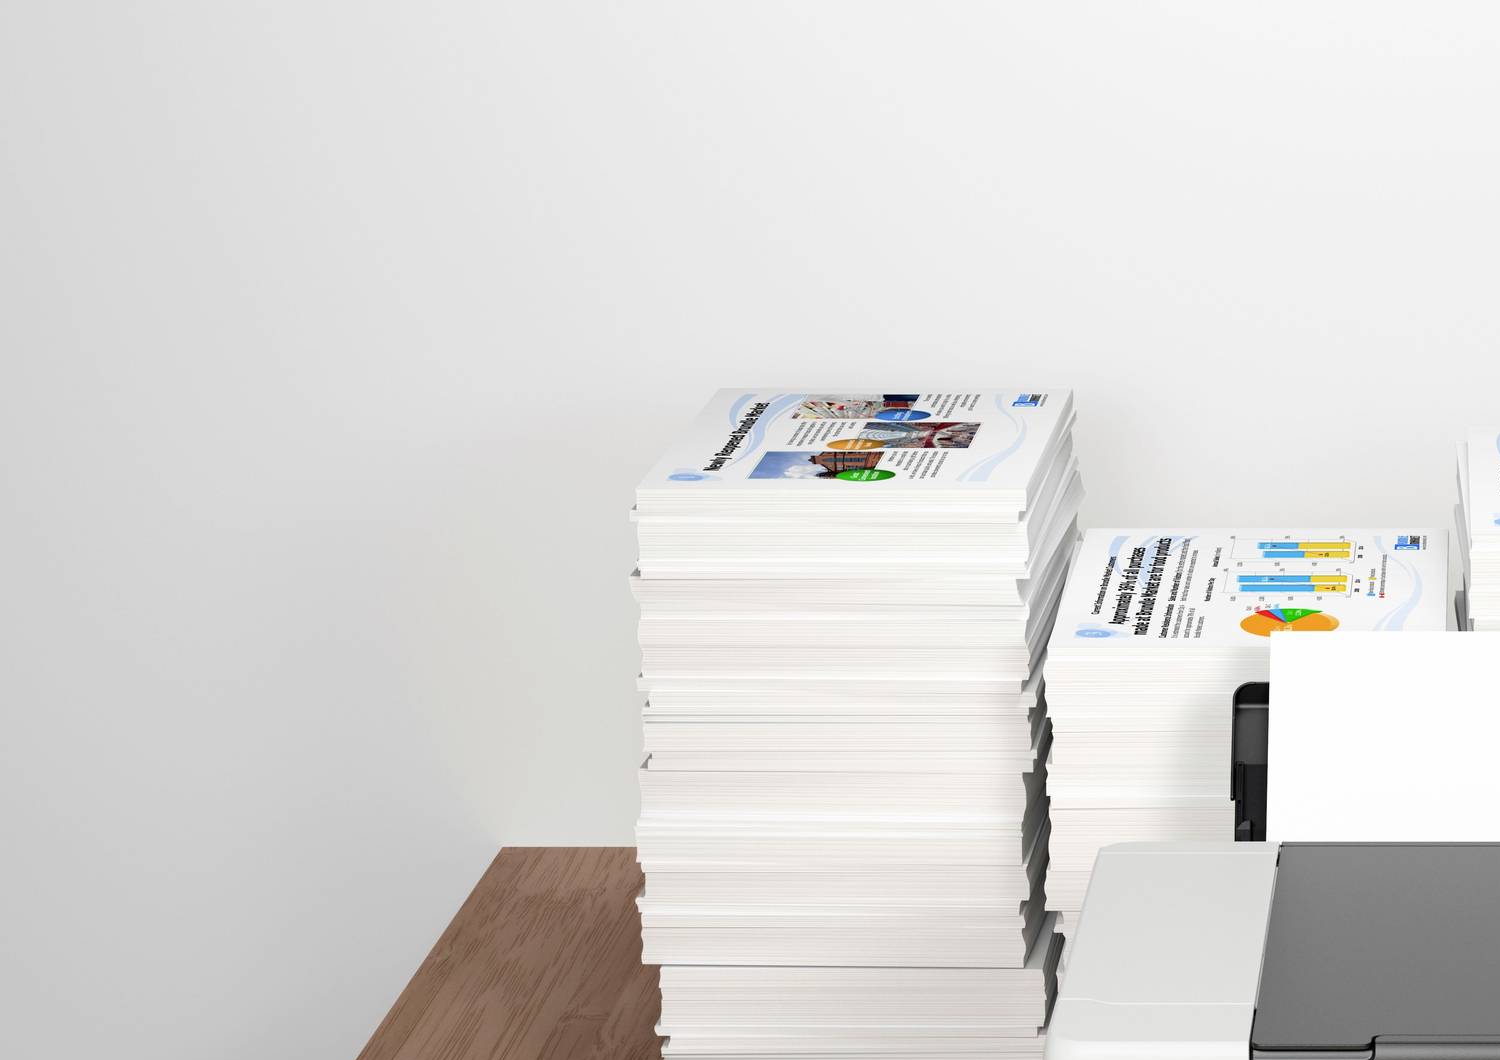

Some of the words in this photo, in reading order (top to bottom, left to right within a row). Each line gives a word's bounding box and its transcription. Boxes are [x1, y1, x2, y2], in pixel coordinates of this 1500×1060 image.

[744, 402, 771, 418] Market
[731, 417, 759, 435] Brundle
[714, 434, 746, 457] Reopened
[702, 456, 733, 471] Newly
[1153, 537, 1172, 557] products
[1126, 546, 1147, 569] purchases
[1148, 556, 1168, 567] food
[1146, 566, 1164, 574] for
[1148, 573, 1163, 582] are
[1117, 580, 1137, 592] 36%
[1140, 581, 1161, 598] Market
[1108, 591, 1137, 625] Approximately
[1135, 597, 1157, 616] Brundle
[1131, 621, 1150, 636] made
